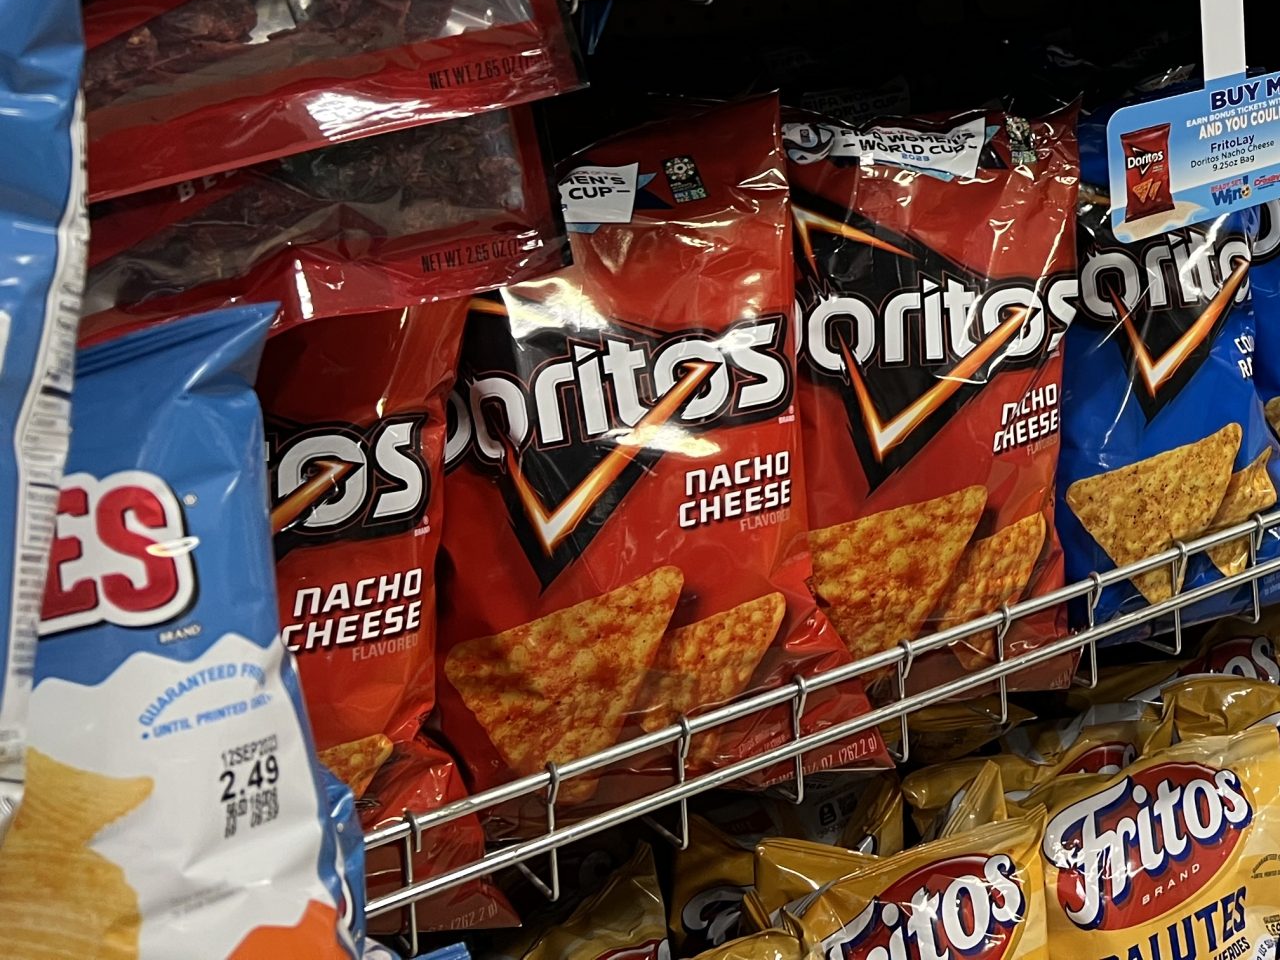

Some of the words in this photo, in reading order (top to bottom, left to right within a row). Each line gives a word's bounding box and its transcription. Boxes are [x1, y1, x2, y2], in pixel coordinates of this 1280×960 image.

[429, 68, 450, 90] NET
[452, 65, 473, 86] WT.
[476, 61, 500, 82] 2.65
[502, 58, 518, 78] OZ
[1210, 81, 1260, 112] BUY
[1186, 116, 1208, 128] EARN
[1209, 109, 1236, 123] BONUS
[1237, 102, 1268, 117] TICKETS
[1199, 122, 1223, 140] AND
[1225, 115, 1248, 133] YOU
[860, 138, 925, 156] WORLD
[929, 143, 965, 155] CUP
[1190, 155, 1220, 168] Doritos
[1221, 147, 1246, 160] Nacho
[1248, 139, 1275, 153] Cheese
[1210, 133, 1256, 154] FritoLay
[1127, 149, 1164, 170] Doritos
[1212, 158, 1239, 172] 9.25oz
[1240, 154, 1256, 168] Bag
[569, 188, 612, 200] CUP
[421, 252, 443, 274] NET
[444, 250, 462, 269] WT.
[467, 244, 490, 265] 2.65
[492, 241, 508, 259] OZ
[1001, 383, 1058, 425] NACHO
[993, 410, 1059, 453] CHEESE
[685, 451, 790, 496] NACHO
[679, 479, 790, 528] CHEESE
[414, 526, 431, 536] BRAND
[739, 509, 790, 533] FLAVORED
[293, 568, 422, 618] NACHO
[159, 624, 202, 645] BRAND
[281, 599, 423, 653] CHEESE
[351, 634, 419, 662] FLAVORED
[138, 662, 239, 727] GUARANTEED
[152, 718, 192, 739] UNTIL
[196, 701, 249, 726] PRINTED
[219, 755, 280, 803] 2.49
[1043, 769, 1253, 930] Fritos
[1141, 862, 1201, 906] BRAND
